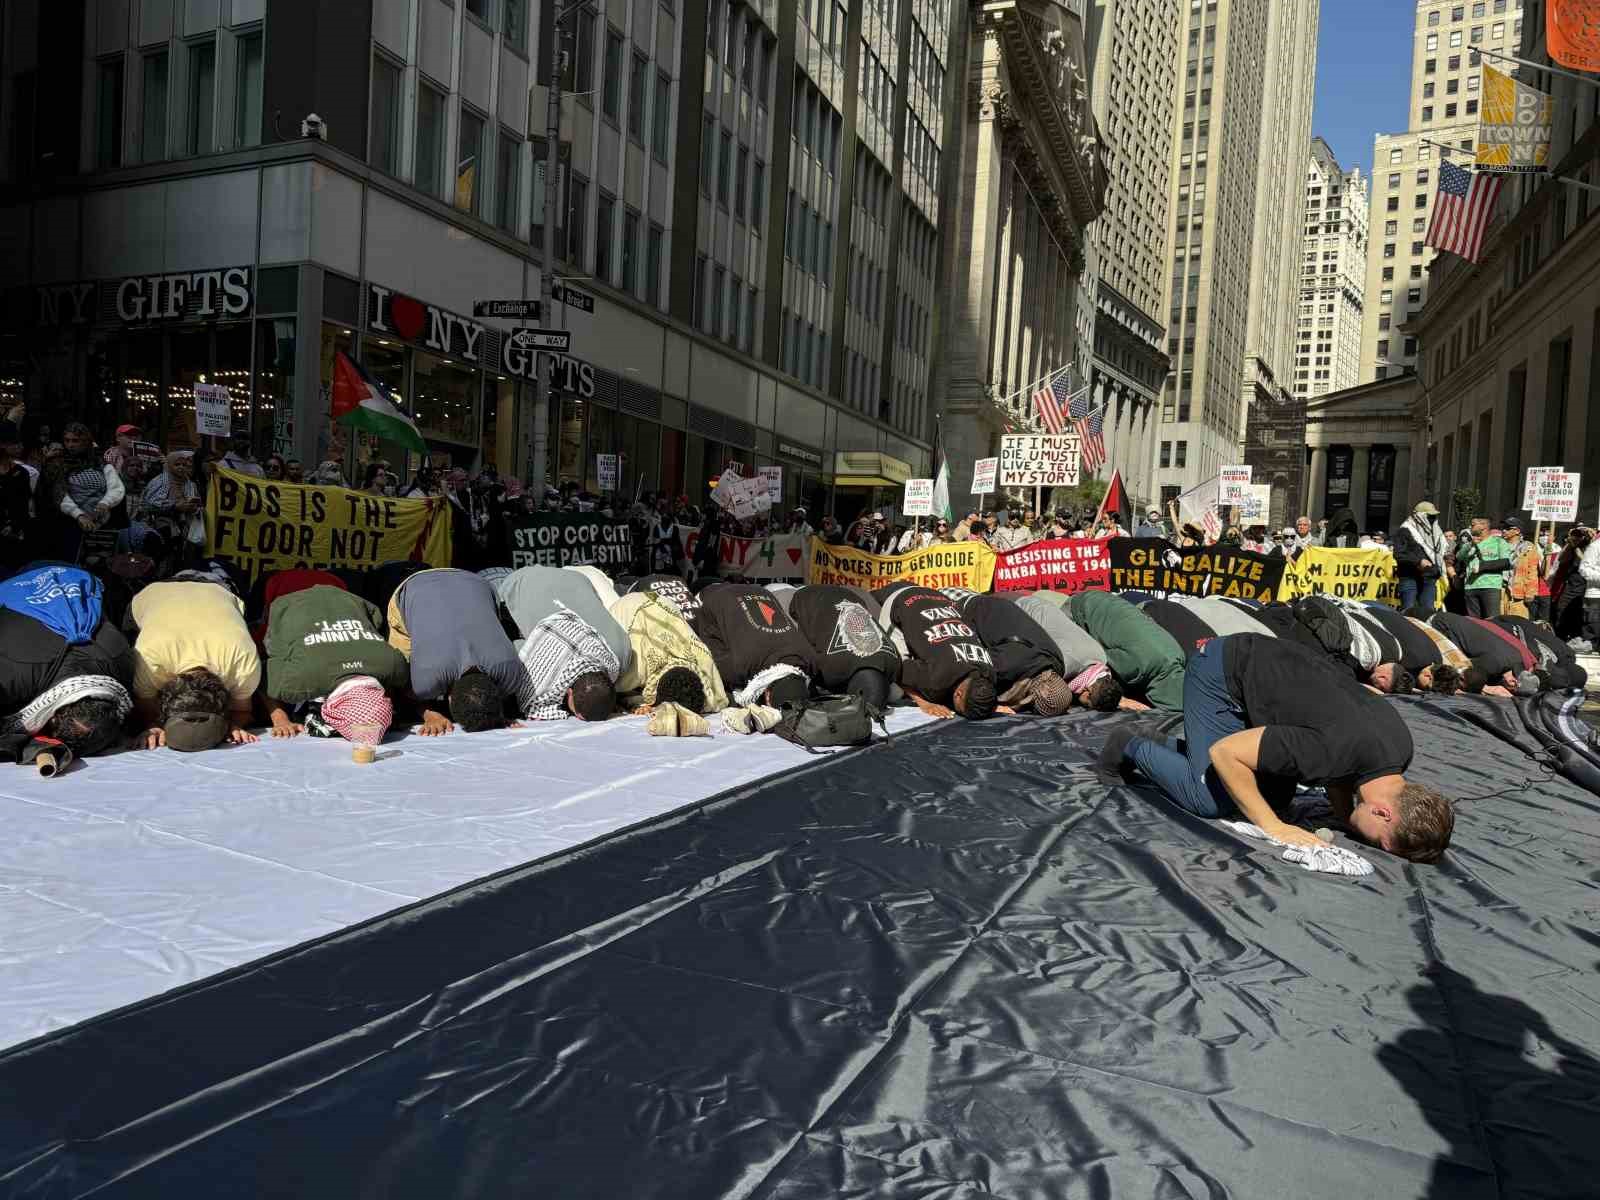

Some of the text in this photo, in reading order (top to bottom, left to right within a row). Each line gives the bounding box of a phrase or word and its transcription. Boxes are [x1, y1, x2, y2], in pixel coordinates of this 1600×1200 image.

[116, 267, 250, 321] GIFTS
[370, 285, 392, 331] I
[425, 306, 484, 361] NY
[520, 335, 564, 345] ONE WAY
[1006, 438, 1080, 450] IF I MUST
[1030, 451, 1039, 462] U
[1041, 451, 1078, 462] MUST
[1002, 461, 1032, 470] LIVE
[1037, 462, 1044, 470] 2
[1049, 463, 1078, 472] TELL
[1006, 471, 1076, 484] MY STORY
[221, 478, 396, 529] BDS IS THE
[215, 517, 384, 562] FLOOR NOT
[514, 526, 560, 548] STOP
[564, 524, 599, 544] COP
[512, 544, 632, 570] FREE PALESTIN
[816, 550, 974, 576] NO VOTES FOR GENOCIDE
[1006, 545, 1100, 566] RESISTING THE
[998, 564, 1037, 580] NAKBA
[1040, 561, 1076, 575] SINCE
[1112, 568, 1155, 588] THE
[1336, 564, 1385, 577] JUSTIC
[822, 572, 864, 588] RESIST
[656, 587, 689, 596] TOLE
[1334, 582, 1368, 598] OUR
[304, 629, 384, 646] TRAINING
[924, 624, 973, 642] OVER
